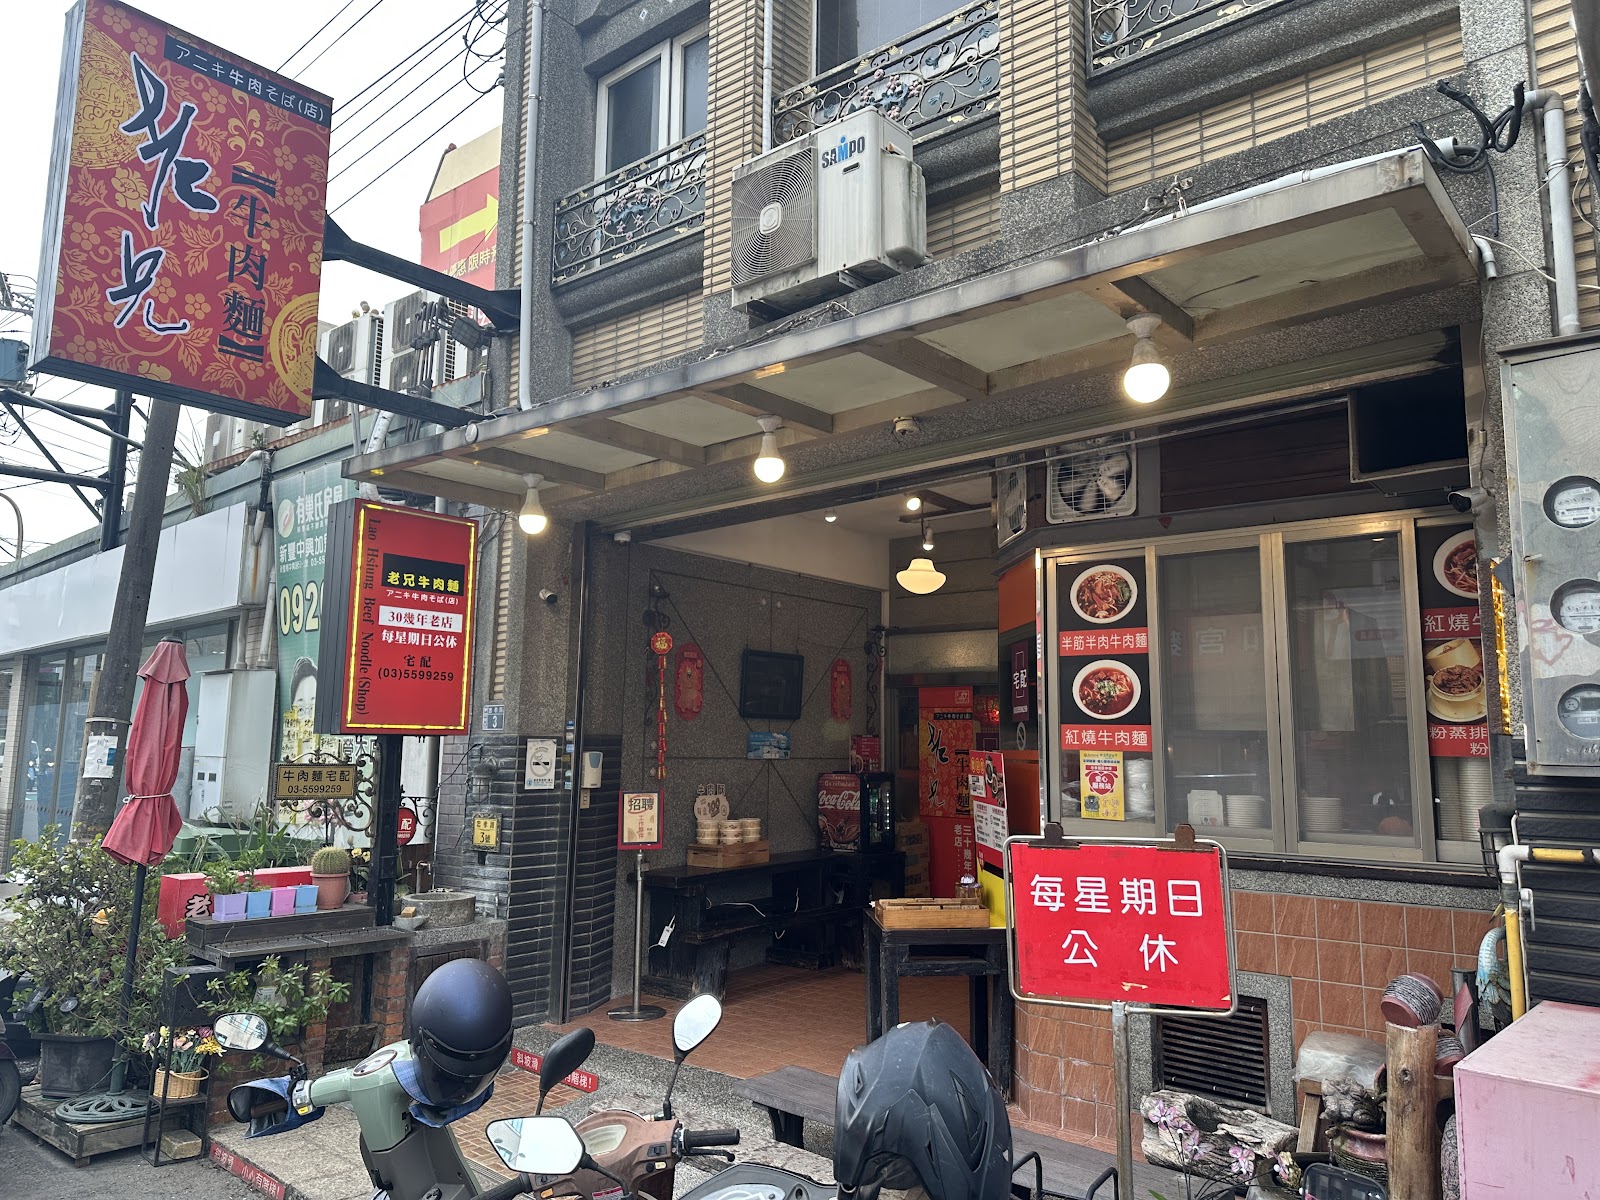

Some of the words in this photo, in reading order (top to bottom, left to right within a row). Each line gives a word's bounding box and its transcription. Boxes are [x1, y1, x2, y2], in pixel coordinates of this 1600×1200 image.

[175, 44, 325, 122] アニキ牛肉そば(店)
[821, 136, 866, 169] SAMPO
[367, 518, 380, 541] Lao
[363, 547, 379, 590] Hsiung
[387, 571, 459, 593] 老兄牛肉麵
[386, 589, 459, 605] アニキ牛肉そば(店)
[280, 580, 325, 636] 092
[361, 597, 376, 625] Beef
[388, 611, 453, 629] 30幾年老店
[381, 629, 457, 649] 每星期日公休
[655, 637, 668, 649] 福
[1061, 633, 1148, 651] 半筋半肉牛肉麵
[358, 631, 374, 674] Noodle
[403, 655, 431, 668] 宅配
[378, 667, 454, 682] (03)5599259
[1012, 669, 1028, 690] 宅配
[355, 674, 372, 716] (Shop)
[492, 715, 498, 728] 3
[1065, 729, 1148, 746] 紅燒牛肉麵
[1429, 726, 1488, 740] 粉蒸排
[283, 770, 350, 783] 牛肉麵宅配
[287, 784, 342, 794] 03-5599259
[628, 798, 654, 811] 招聘
[818, 789, 861, 811] Coca-Cola
[400, 818, 413, 831] 配
[963, 825, 972, 879] 三十幾年
[1030, 873, 1203, 917] 每星期日
[186, 894, 212, 918] 老
[1061, 929, 1179, 973] 公休
[516, 1052, 539, 1071] 斜坡滑
